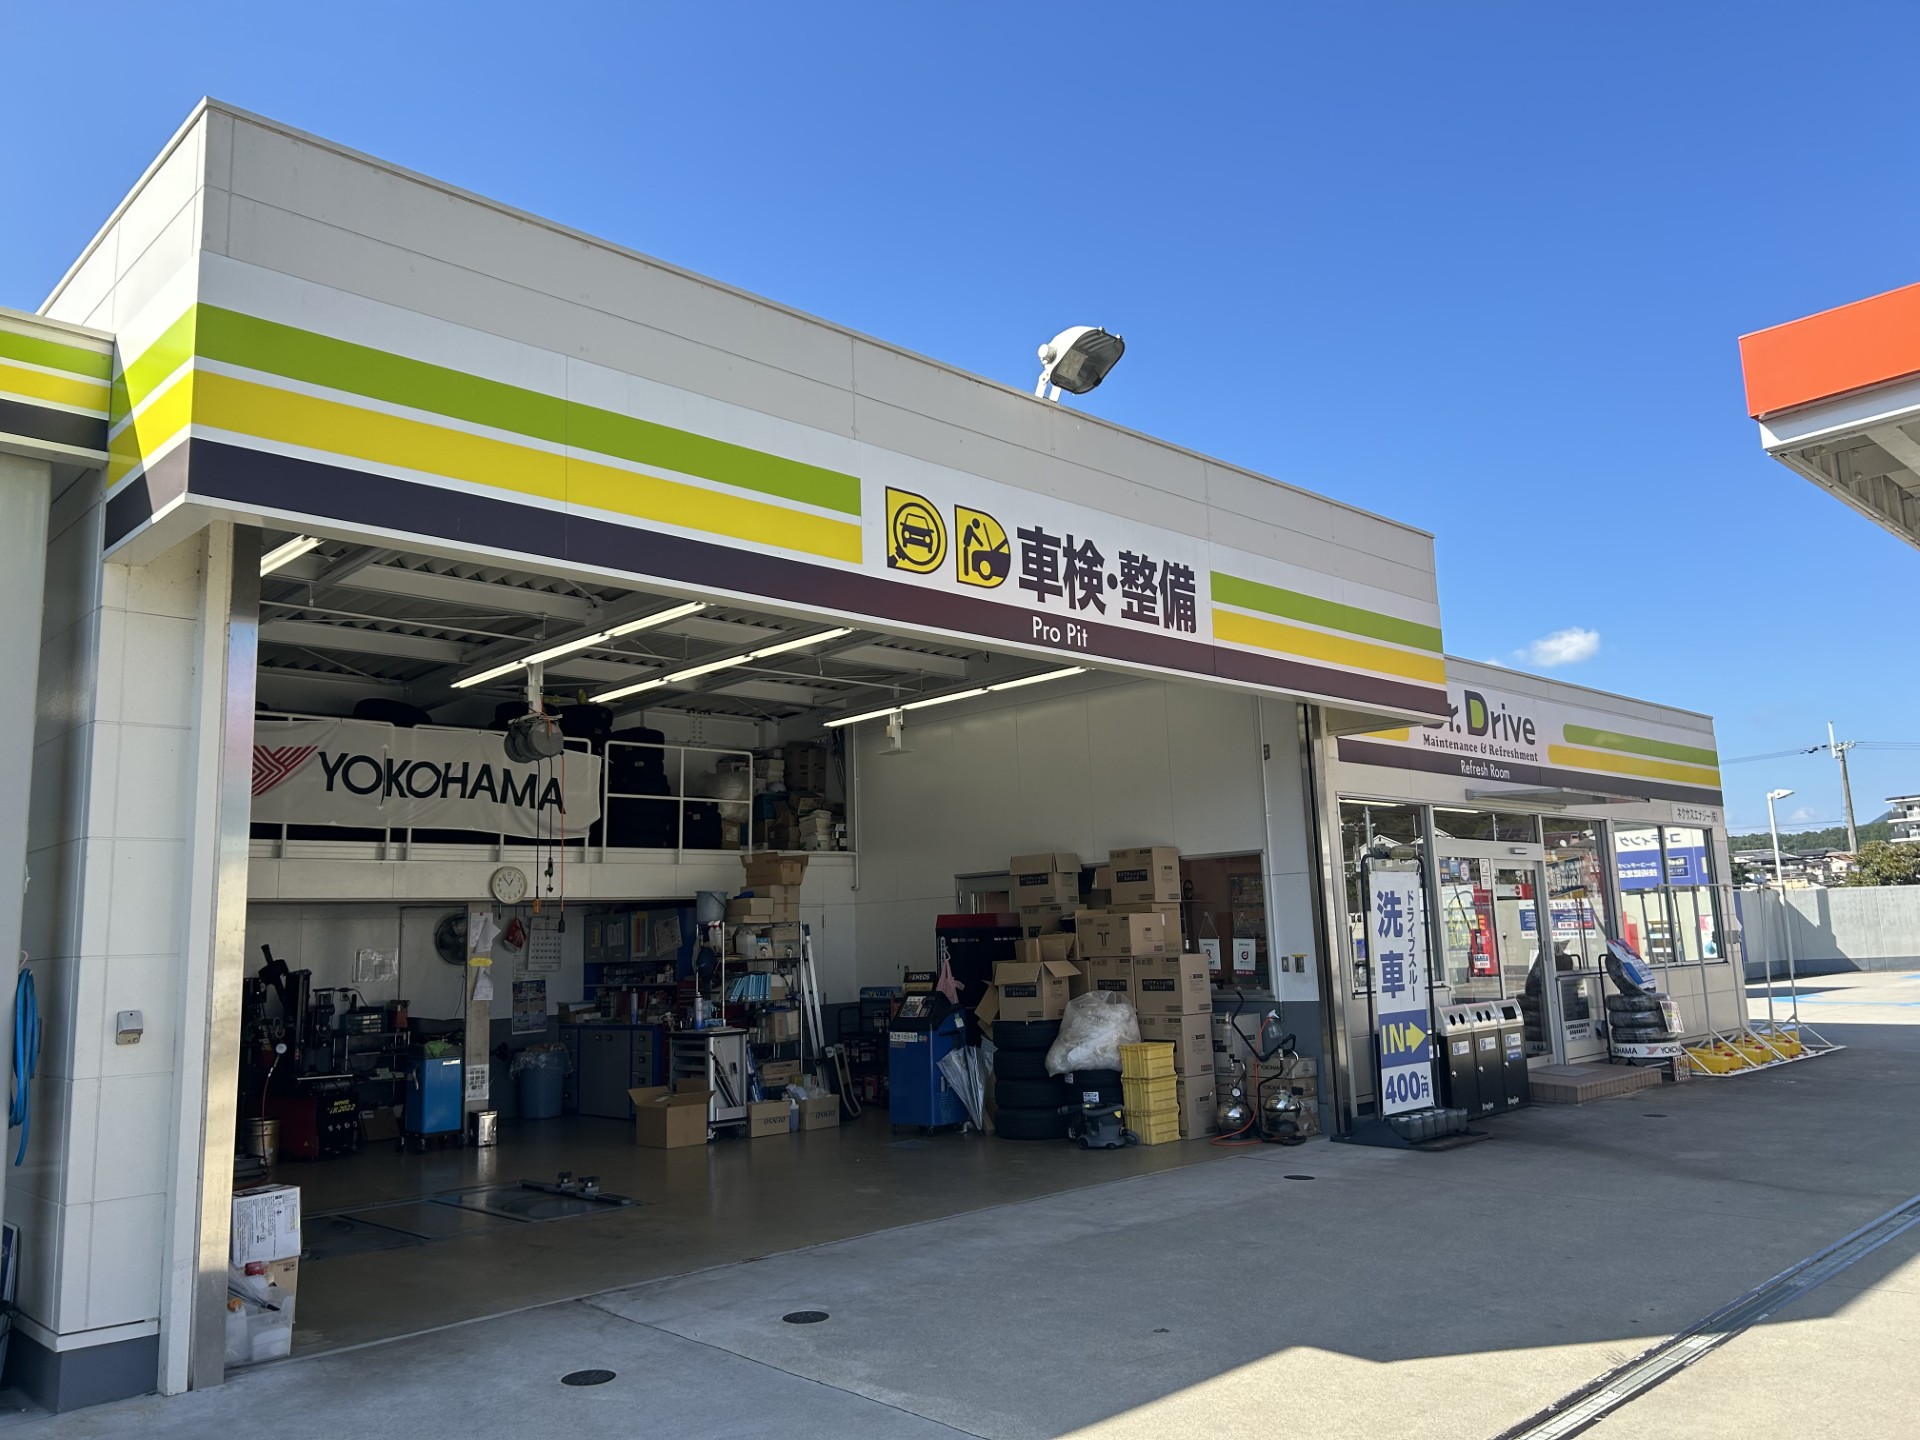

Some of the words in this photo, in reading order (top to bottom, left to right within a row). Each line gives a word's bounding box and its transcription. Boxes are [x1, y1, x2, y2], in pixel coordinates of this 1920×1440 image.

[1016, 525, 1197, 634] 車検・整備
[1032, 615, 1061, 643] Pro
[1067, 623, 1088, 648] Pit
[1422, 689, 1536, 746] r.Drive
[1422, 733, 1478, 753] Maintenance
[1480, 742, 1487, 754] &
[1489, 744, 1539, 762] Refreshment
[1460, 759, 1489, 777] Refresh
[1490, 763, 1511, 780] Room
[317, 751, 567, 815] YOKOHAMA
[1376, 890, 1406, 999] 洗車
[1406, 889, 1418, 1002] ドライブスルー
[1381, 1022, 1406, 1055] IN
